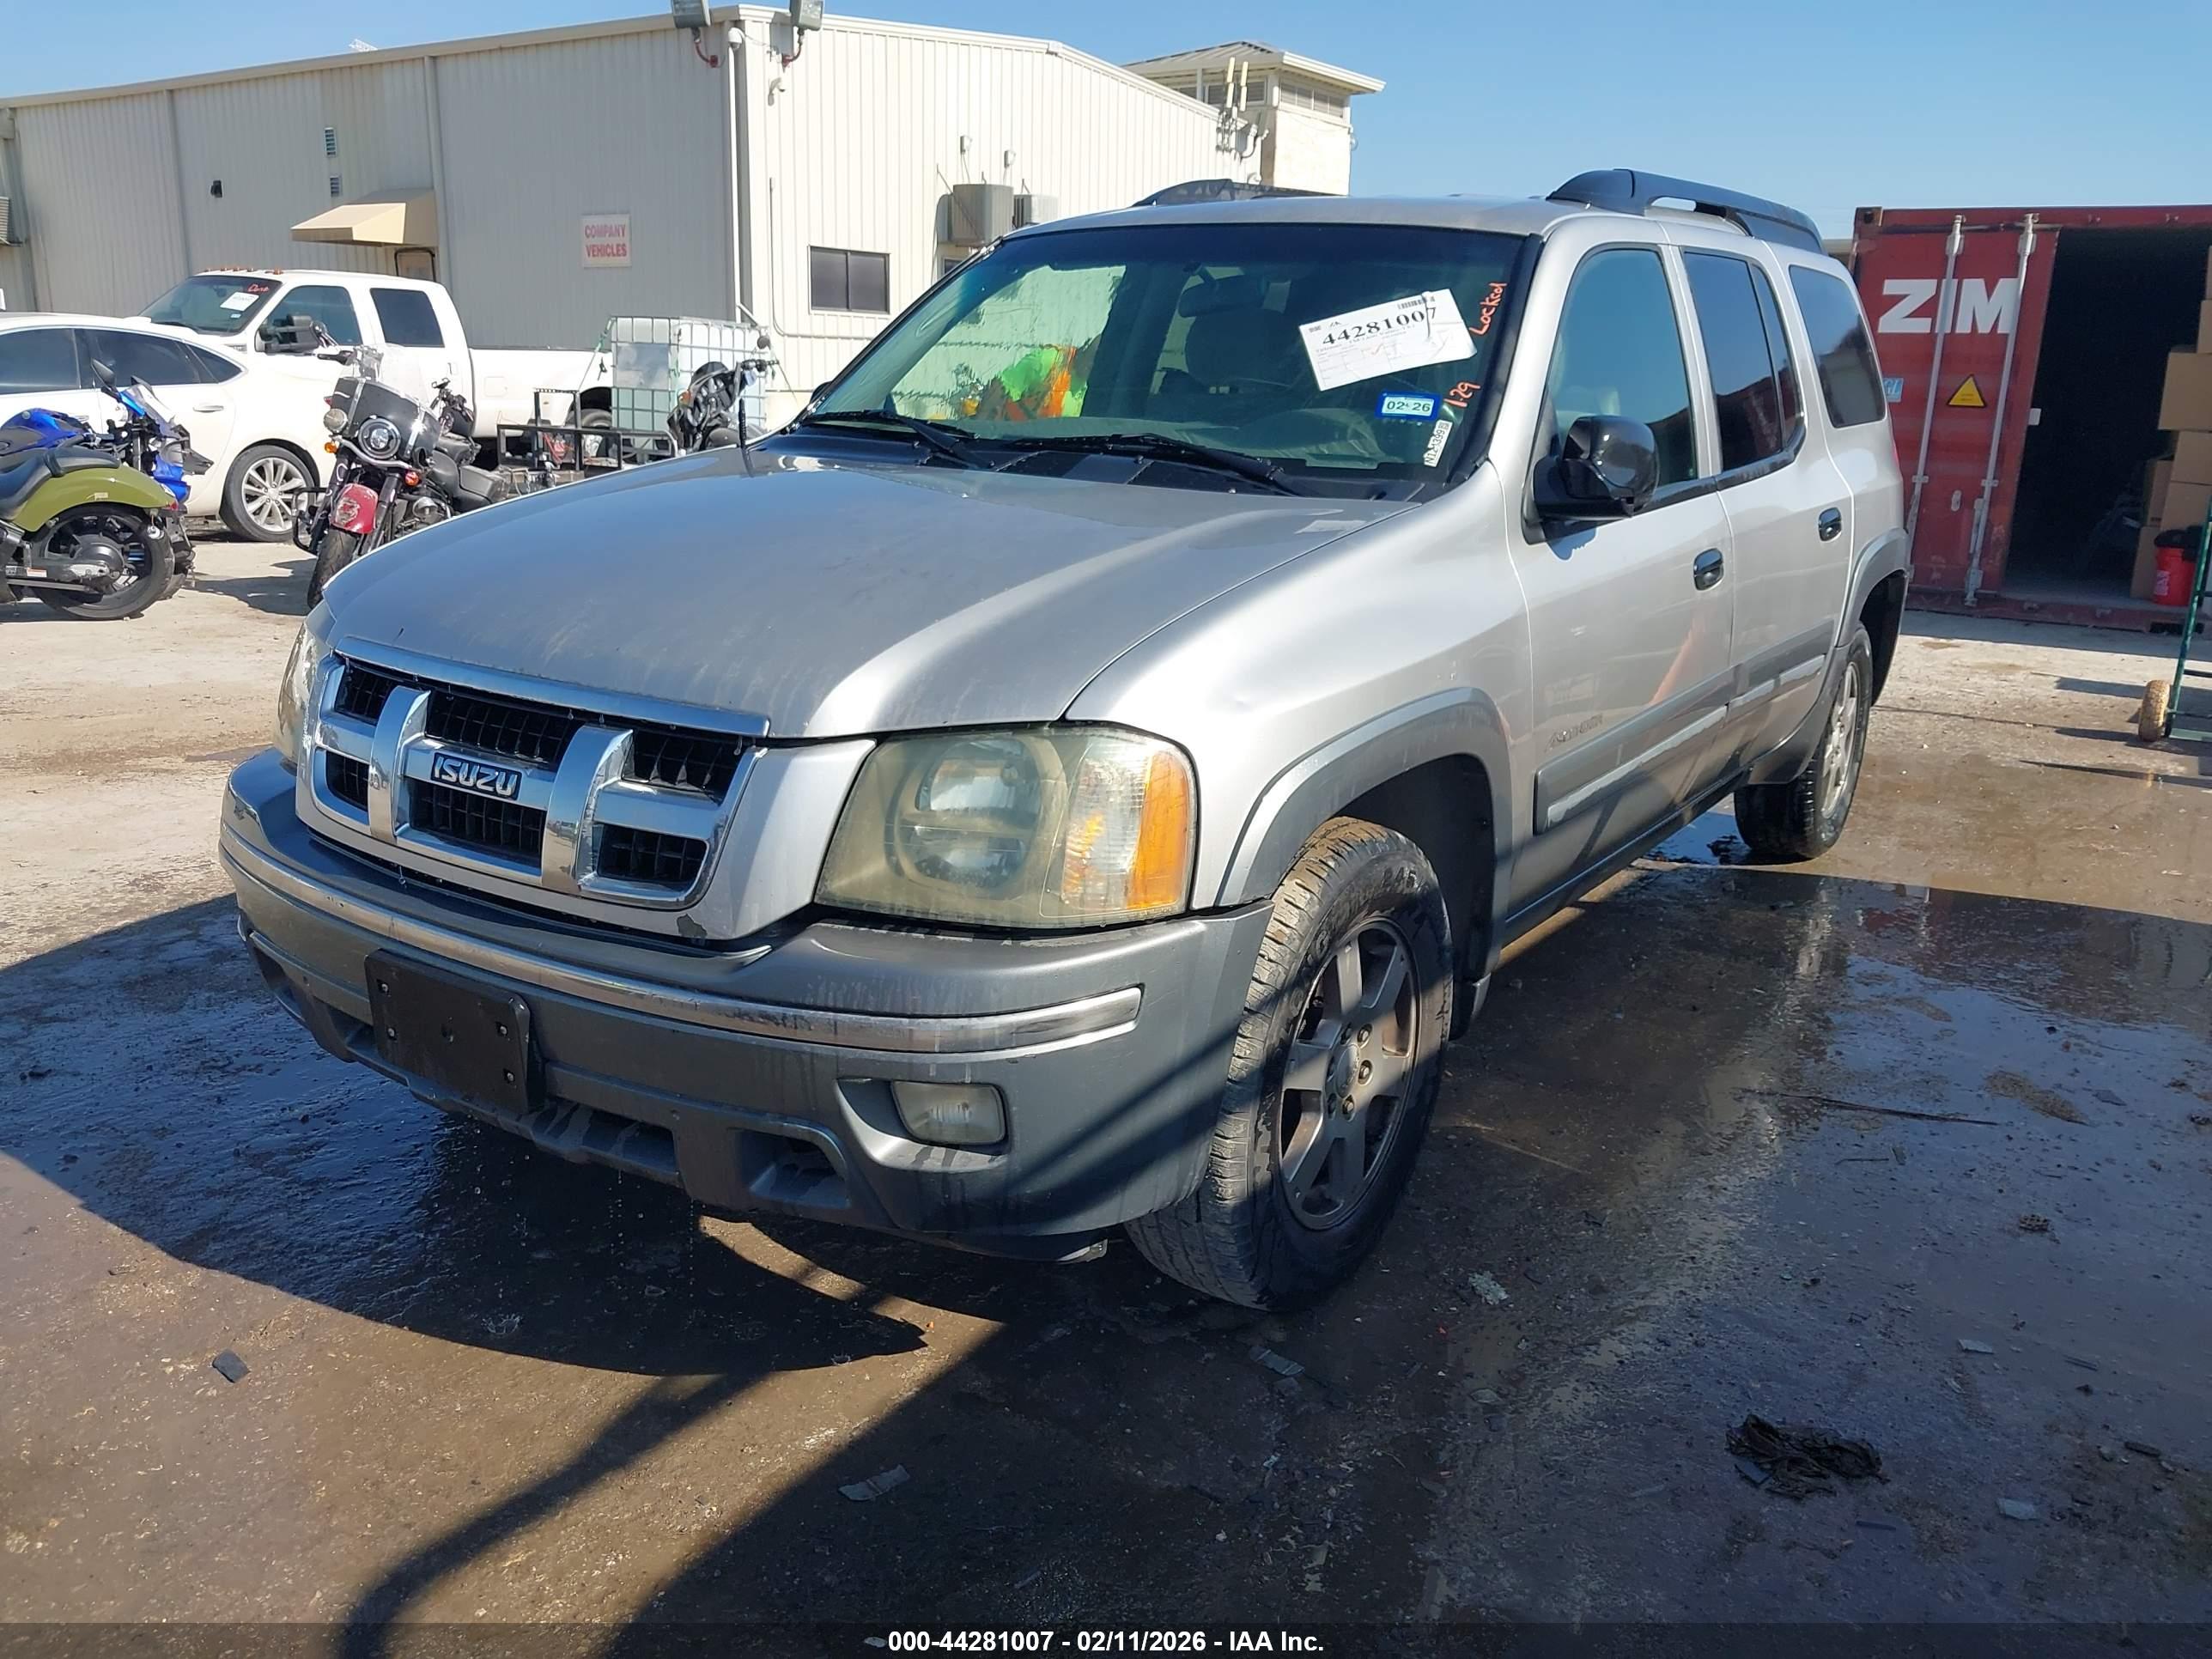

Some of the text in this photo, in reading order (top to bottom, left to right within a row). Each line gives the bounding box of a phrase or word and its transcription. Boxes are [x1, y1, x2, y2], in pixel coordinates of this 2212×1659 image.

[584, 224, 626, 239] COMPANY
[585, 243, 628, 258] VEHICLES
[1878, 278, 2020, 334] ZIM
[1322, 307, 1436, 344] 44281007
[1387, 400, 1431, 412] 02 26
[434, 756, 518, 797] ISUZU
